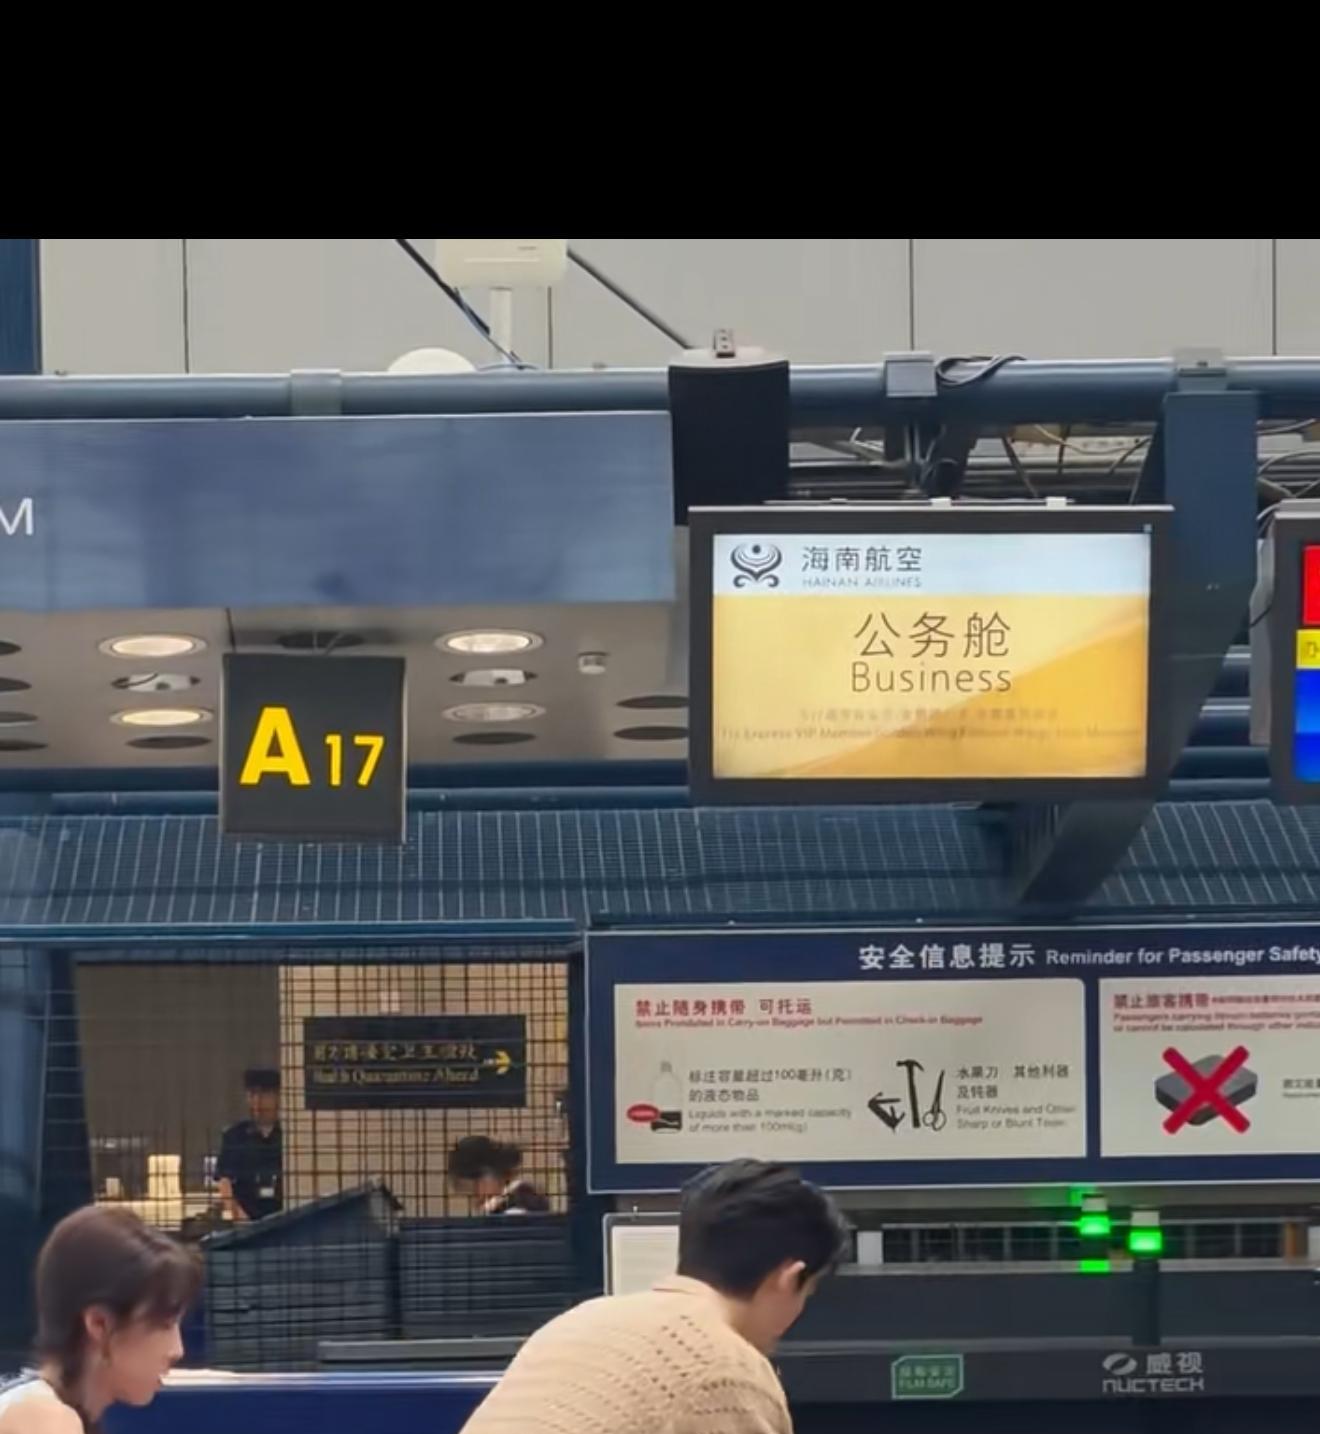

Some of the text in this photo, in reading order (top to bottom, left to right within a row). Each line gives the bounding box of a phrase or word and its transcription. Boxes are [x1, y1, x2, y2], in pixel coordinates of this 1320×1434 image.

[801, 546, 923, 573] 海南航空
[802, 577, 922, 588] HAINAN AIRLINES
[853, 611, 1012, 659] 公务舱
[851, 661, 1013, 694] Business
[240, 705, 385, 788] A 17
[859, 943, 1035, 971] 安全信息提示
[1046, 945, 1320, 969] Reminder for Passenger Safety
[635, 998, 813, 1017] 禁止随身携带 可托运
[956, 1065, 999, 1080] 水果刀
[1145, 1351, 1204, 1375] 威视
